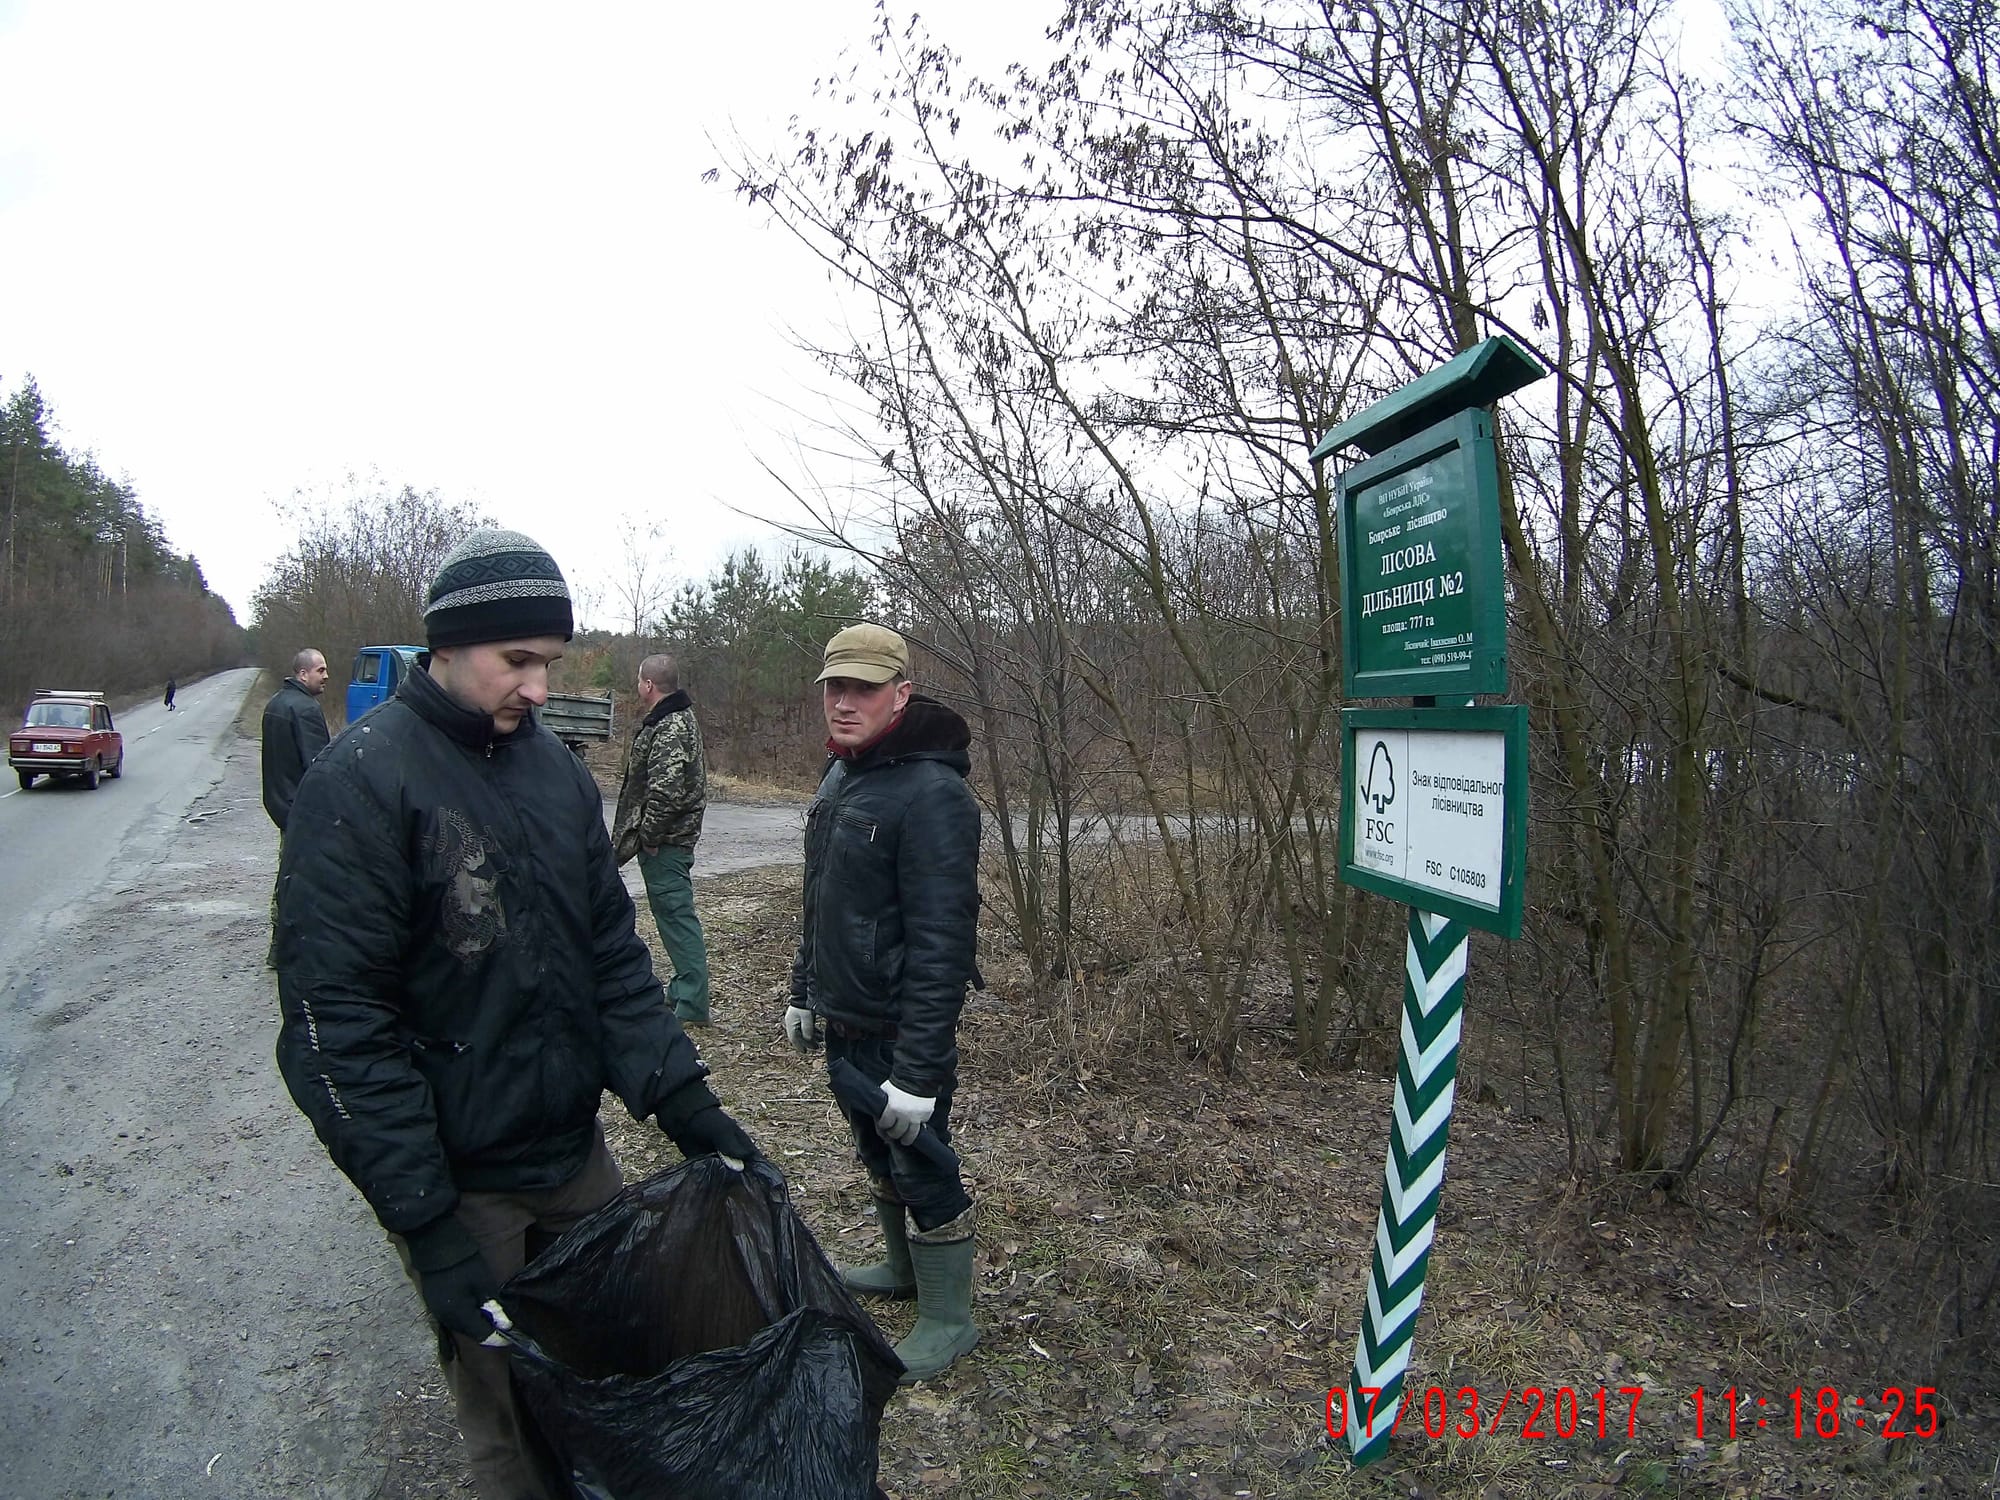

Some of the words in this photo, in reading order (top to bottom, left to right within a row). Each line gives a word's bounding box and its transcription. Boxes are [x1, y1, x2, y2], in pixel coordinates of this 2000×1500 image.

[1368, 525, 1401, 545] Боярське
[1406, 508, 1447, 531] лісництво
[1380, 540, 1437, 576] ЛІСОВА
[1362, 577, 1435, 619] ДІЛЬНИЦЯ
[1439, 571, 1464, 598] №2
[1382, 621, 1408, 634] площа:
[1409, 615, 1423, 629] 777
[1425, 616, 1435, 627] га
[1412, 769, 1432, 788] Знак
[1433, 772, 1505, 796] відповідальног
[1432, 794, 1484, 818] лісівництва
[1365, 818, 1394, 844] FSC
[1365, 848, 1394, 866] www.fsc.org
[1425, 860, 1442, 876] FSC
[1450, 866, 1486, 889] C105803
